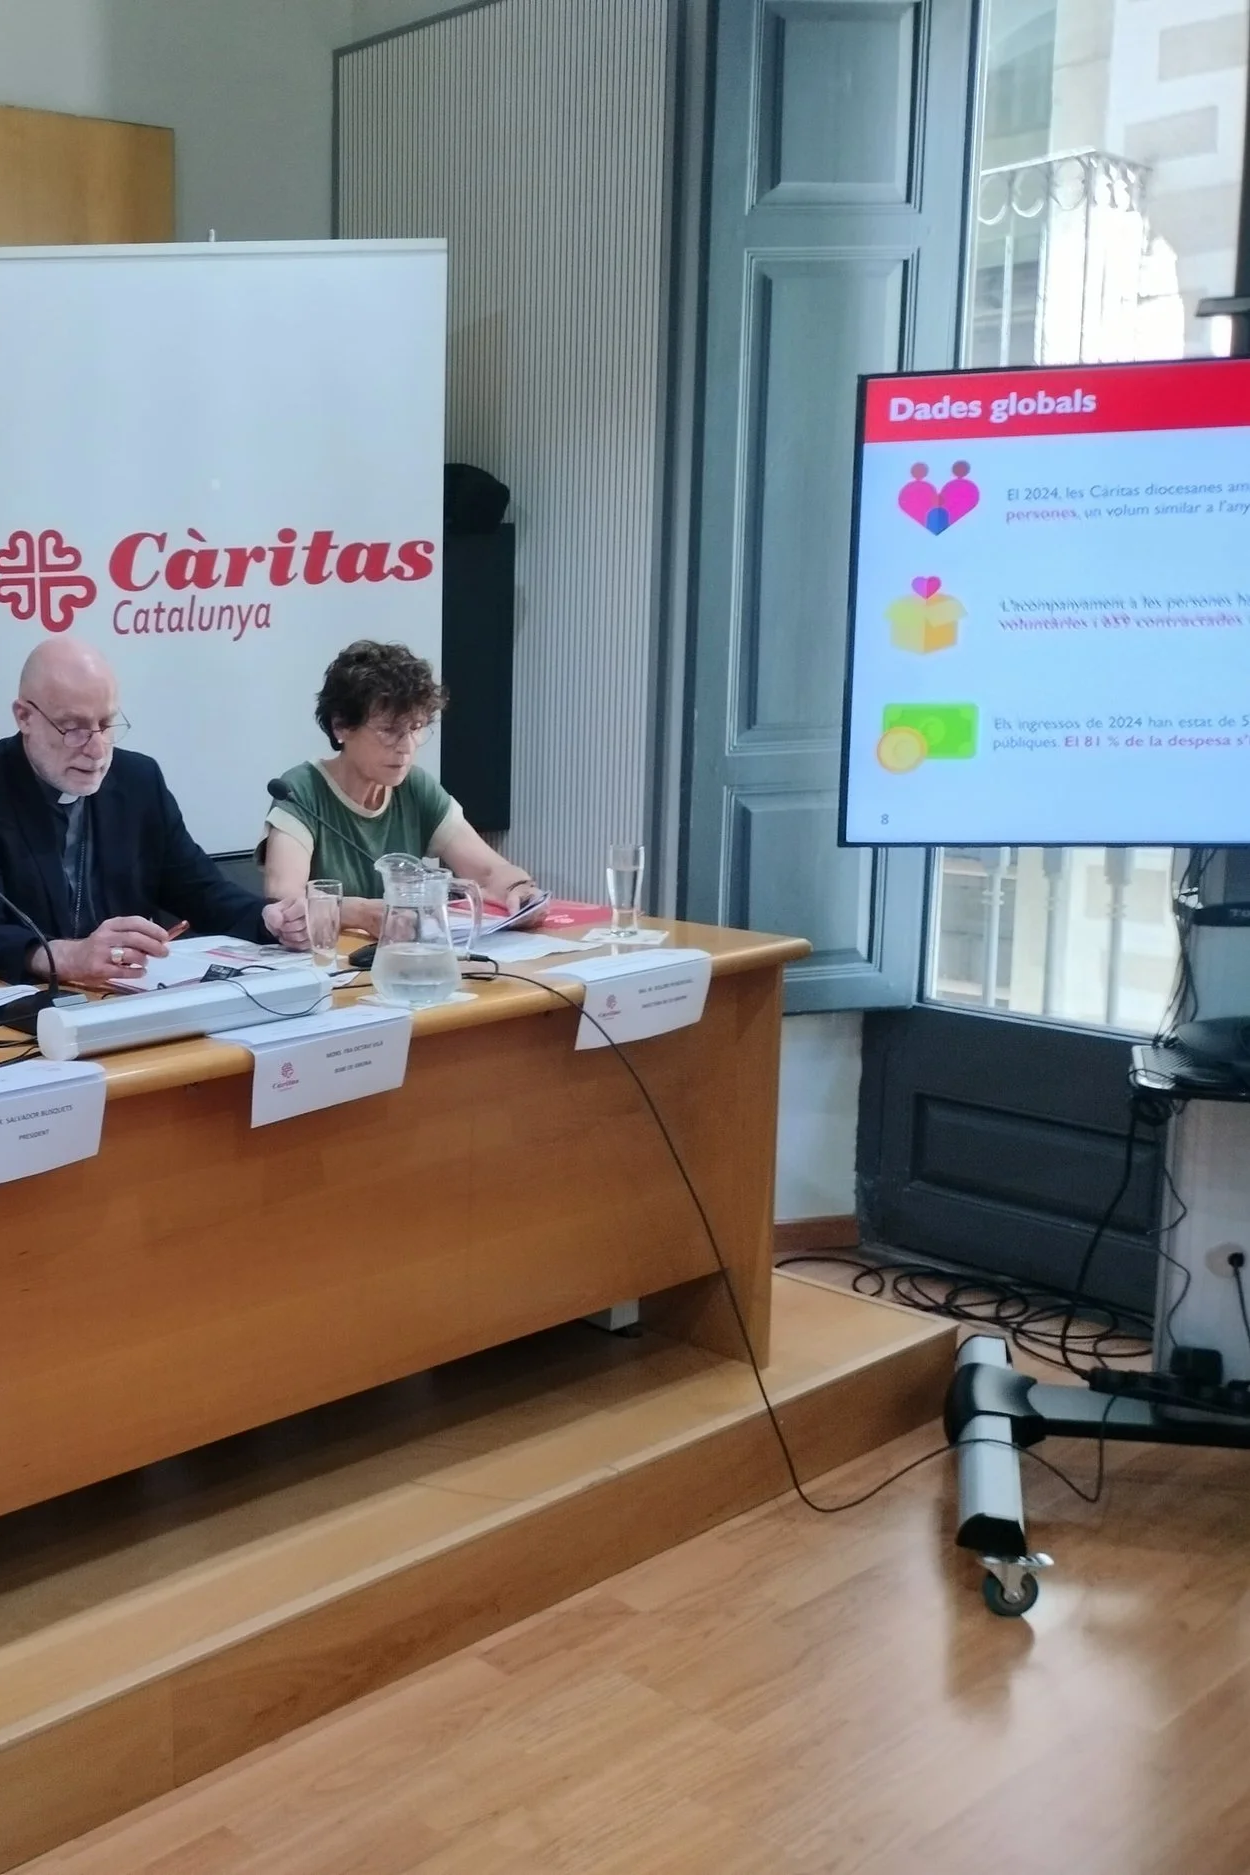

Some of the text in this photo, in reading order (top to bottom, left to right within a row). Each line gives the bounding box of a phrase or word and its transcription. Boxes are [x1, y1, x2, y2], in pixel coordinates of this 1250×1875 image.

[890, 389, 1097, 423] Dades globals
[1007, 488, 1019, 501] El
[1066, 486, 1084, 499] les
[1145, 482, 1223, 496] diocesanes
[1085, 508, 1101, 518] un
[1106, 504, 1150, 517] volum
[1154, 501, 1201, 515] similar
[1206, 503, 1214, 513] a
[108, 528, 435, 591] Càritas
[113, 595, 271, 641] Catalunya
[994, 718, 1012, 731] Els
[1017, 718, 1081, 733] ingressos
[1086, 717, 1104, 729] de
[1109, 715, 1143, 729] 2024
[1147, 716, 1173, 728] han
[1178, 717, 1213, 728] estat
[1217, 715, 1236, 728] de
[1065, 736, 1079, 748] El
[1085, 735, 1100, 747] 81
[1108, 735, 1120, 747] %
[1125, 735, 1144, 747] de
[1149, 735, 1162, 747] la
[1168, 734, 1230, 750] despesa
[880, 813, 889, 825] 8
[5, 1111, 39, 1124] SALVADOR
[18, 1128, 49, 1140] PRESIDENT
